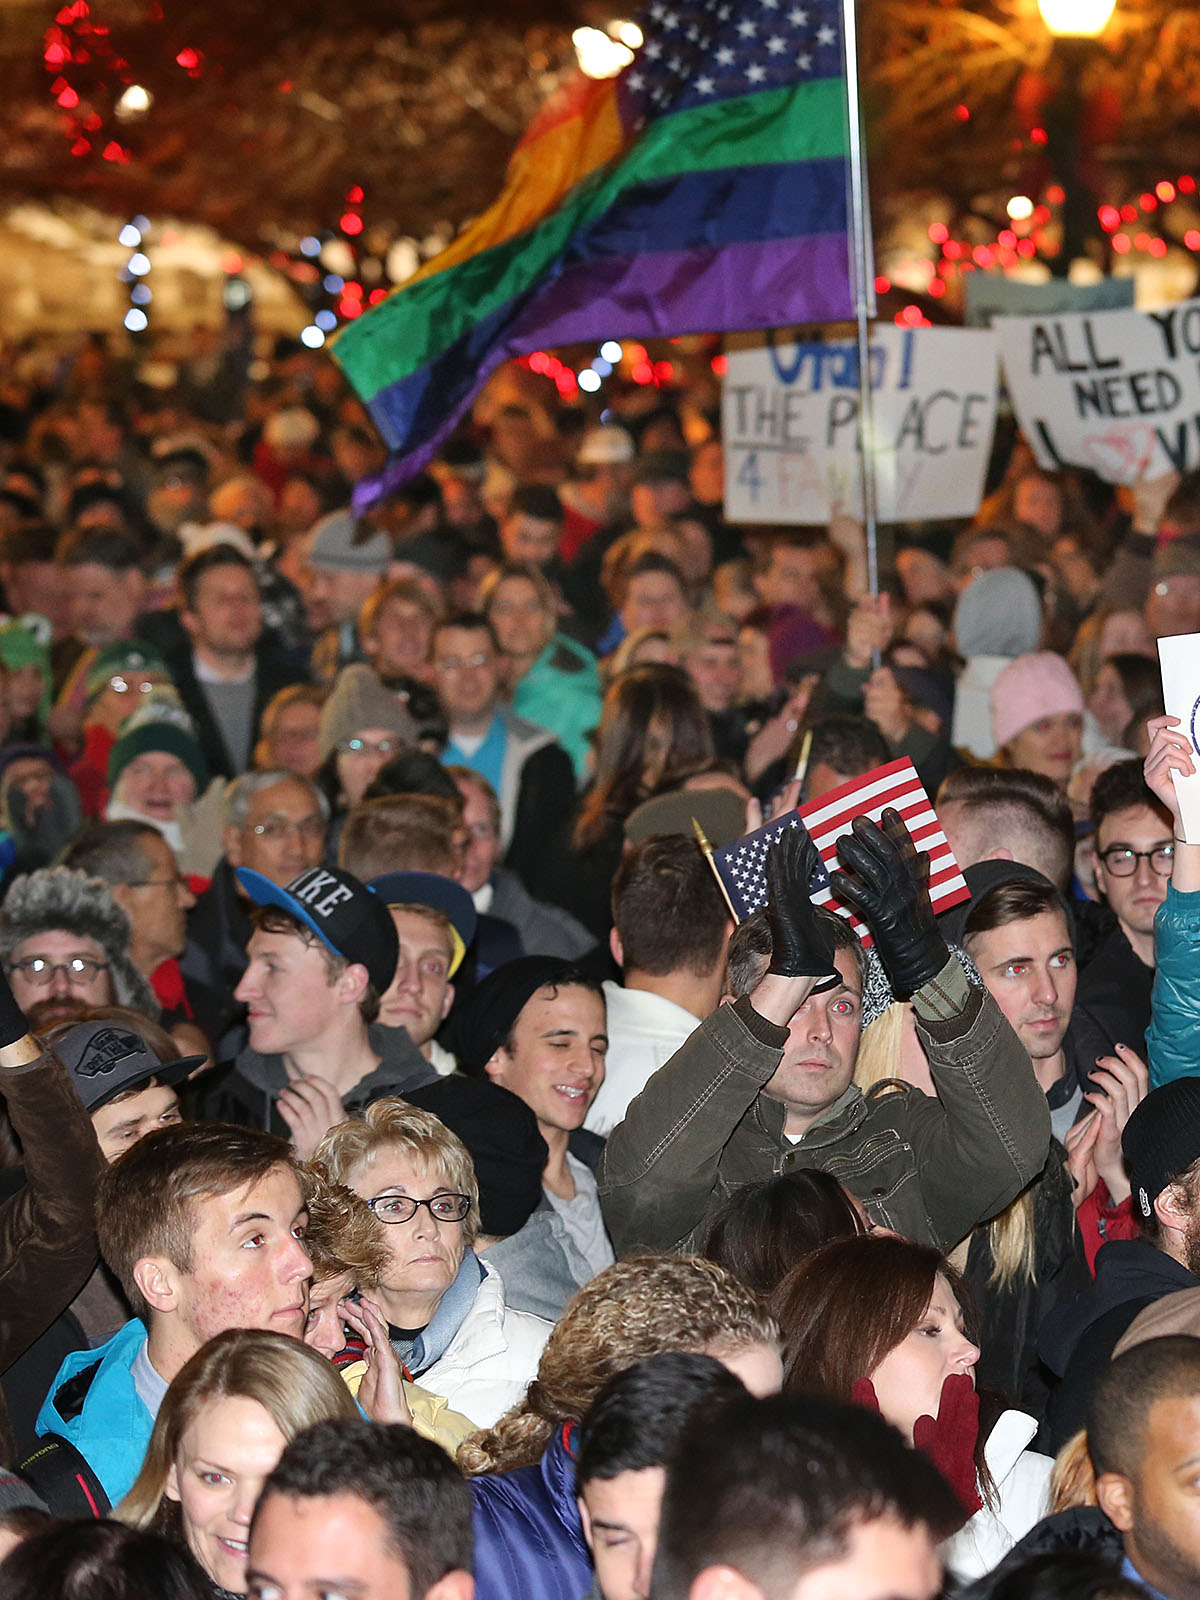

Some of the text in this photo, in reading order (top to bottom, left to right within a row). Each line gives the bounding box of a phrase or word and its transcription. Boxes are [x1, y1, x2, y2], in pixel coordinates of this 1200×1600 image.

[1031, 319, 1122, 375] ALL
[730, 385, 813, 442] THE
[1073, 370, 1182, 420] NEED
[737, 453, 768, 502] 4
[287, 866, 354, 918] IKE
